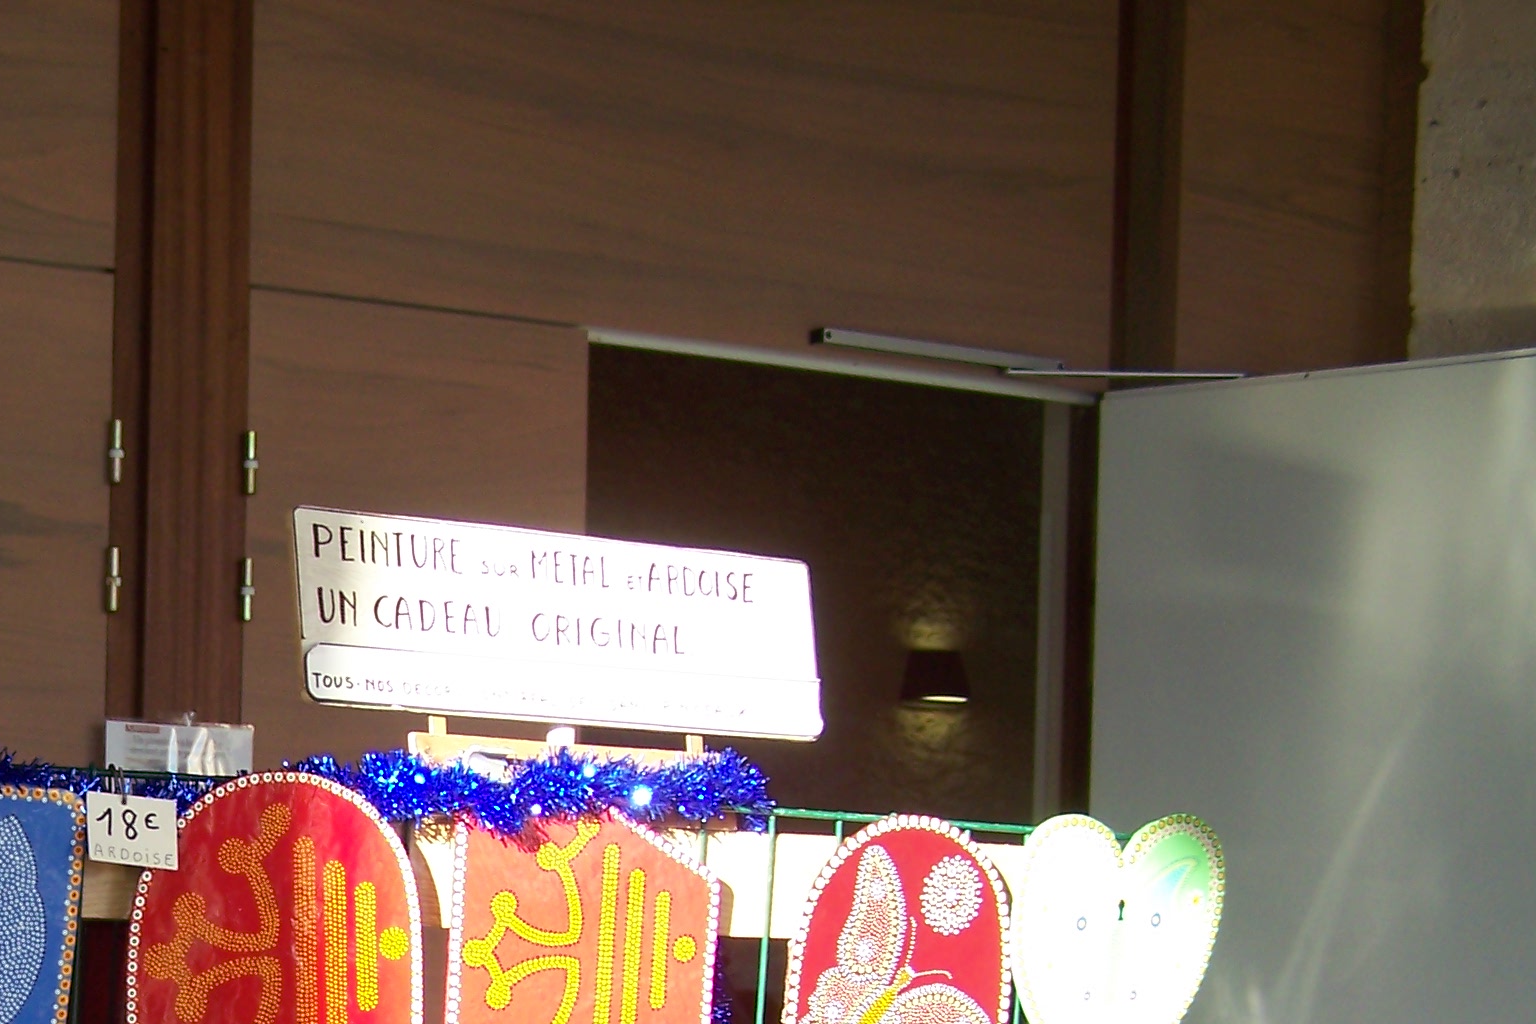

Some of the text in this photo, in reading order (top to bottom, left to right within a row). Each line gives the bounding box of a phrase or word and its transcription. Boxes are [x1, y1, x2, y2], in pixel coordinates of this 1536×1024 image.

[317, 586, 685, 655] UN CADEAU ORIGINAL
[96, 807, 159, 840] 18€
